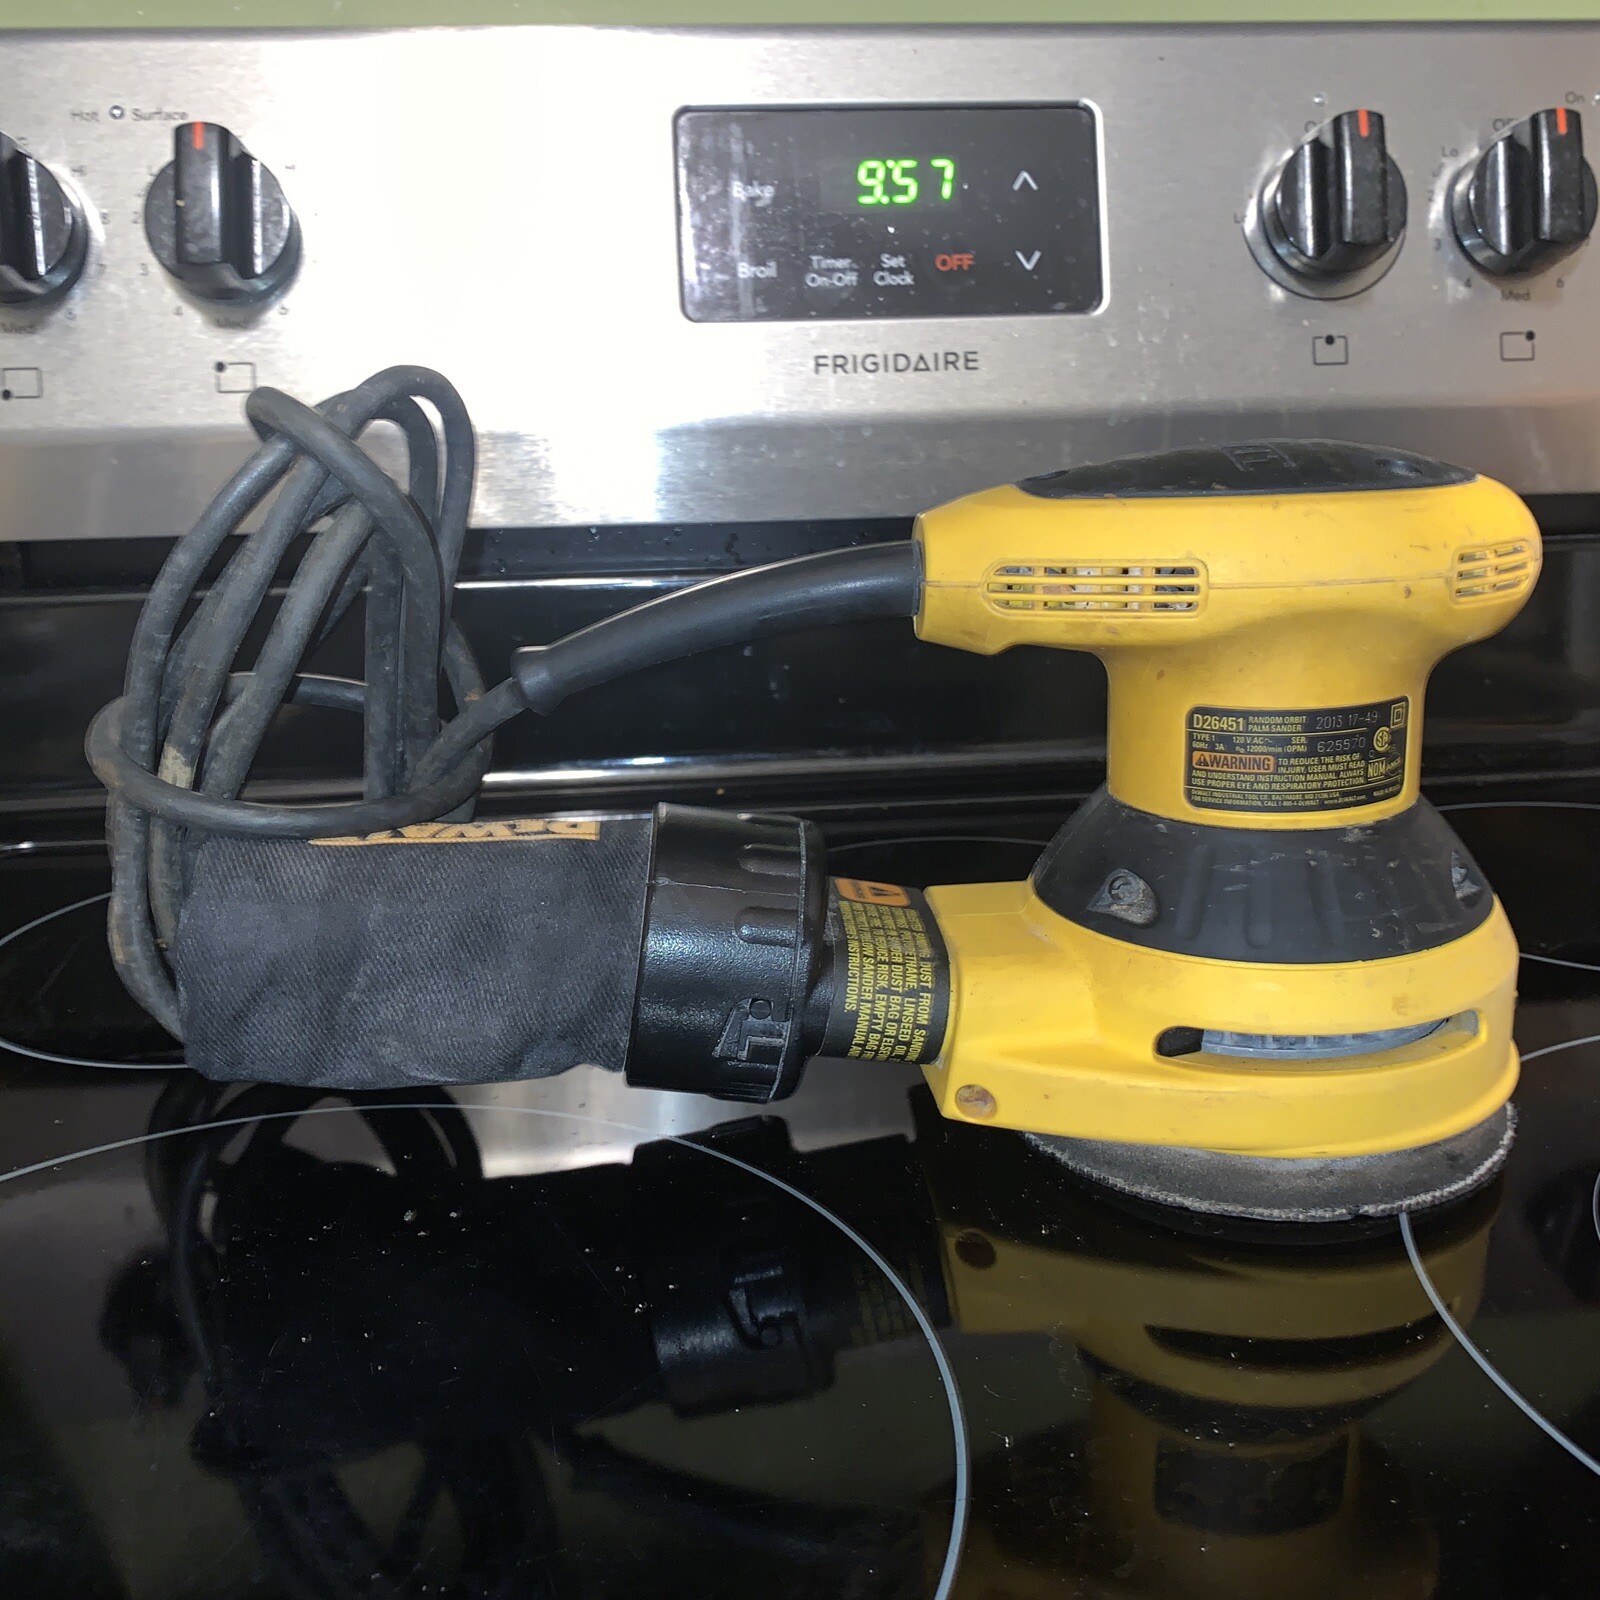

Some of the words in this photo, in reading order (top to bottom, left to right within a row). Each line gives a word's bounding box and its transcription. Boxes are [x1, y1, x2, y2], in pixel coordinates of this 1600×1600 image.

[131, 107, 189, 121] Surface
[731, 180, 775, 201] Bake
[737, 260, 777, 279] Broil
[809, 255, 854, 270] Timer
[880, 253, 906, 268] Set
[934, 253, 976, 272] OFF
[805, 271, 859, 288] On-Off
[873, 270, 915, 287] Clock
[813, 351, 980, 375] FRIGIDAIRE
[1193, 714, 1245, 732] D26451
[1248, 716, 1283, 724] RANDOM
[1284, 716, 1307, 724] ORBIT
[1248, 724, 1270, 732] PALM
[1193, 733, 1210, 742] TYPE
[1233, 736, 1246, 744] 120
[1246, 736, 1253, 744] V
[1215, 743, 1225, 751] 3A
[1210, 754, 1271, 771] WARNING
[1278, 758, 1289, 766] TO
[1290, 757, 1319, 766] REDUCE
[1321, 755, 1335, 763] THE
[1336, 753, 1351, 762] RISK
[1352, 752, 1361, 760] OF
[1307, 764, 1327, 772] USER
[1328, 762, 1348, 771] MUST
[1349, 760, 1366, 769] READ
[1192, 770, 1206, 778] AND
[1208, 772, 1255, 782] UNDERSTAND
[1256, 774, 1305, 782] INSTRUCTION
[1340, 769, 1365, 778] ALWAYS
[1367, 760, 1386, 778] NOM
[1192, 778, 1206, 786] USE
[1207, 779, 1236, 789] PROPER
[1237, 782, 1252, 790] EYE
[1271, 781, 1322, 791] RESPIRATORY
[875, 936, 889, 962] REDUCE
[844, 940, 861, 1013] INSTRUCTIONS.
[860, 957, 875, 1000] SANDER
[875, 964, 889, 990] RISK,
[891, 964, 904, 993] DUST
[919, 961, 932, 988] DUST
[871, 993, 888, 1031] EMPTY
[888, 995, 902, 1020] BAG
[916, 993, 932, 1025] FROM
[852, 1002, 872, 1045] MANUAL
[898, 997, 917, 1042] LINSEED
[885, 1022, 898, 1037] OR
[865, 1032, 881, 1051] BAG
[892, 1044, 907, 1057] OIL
